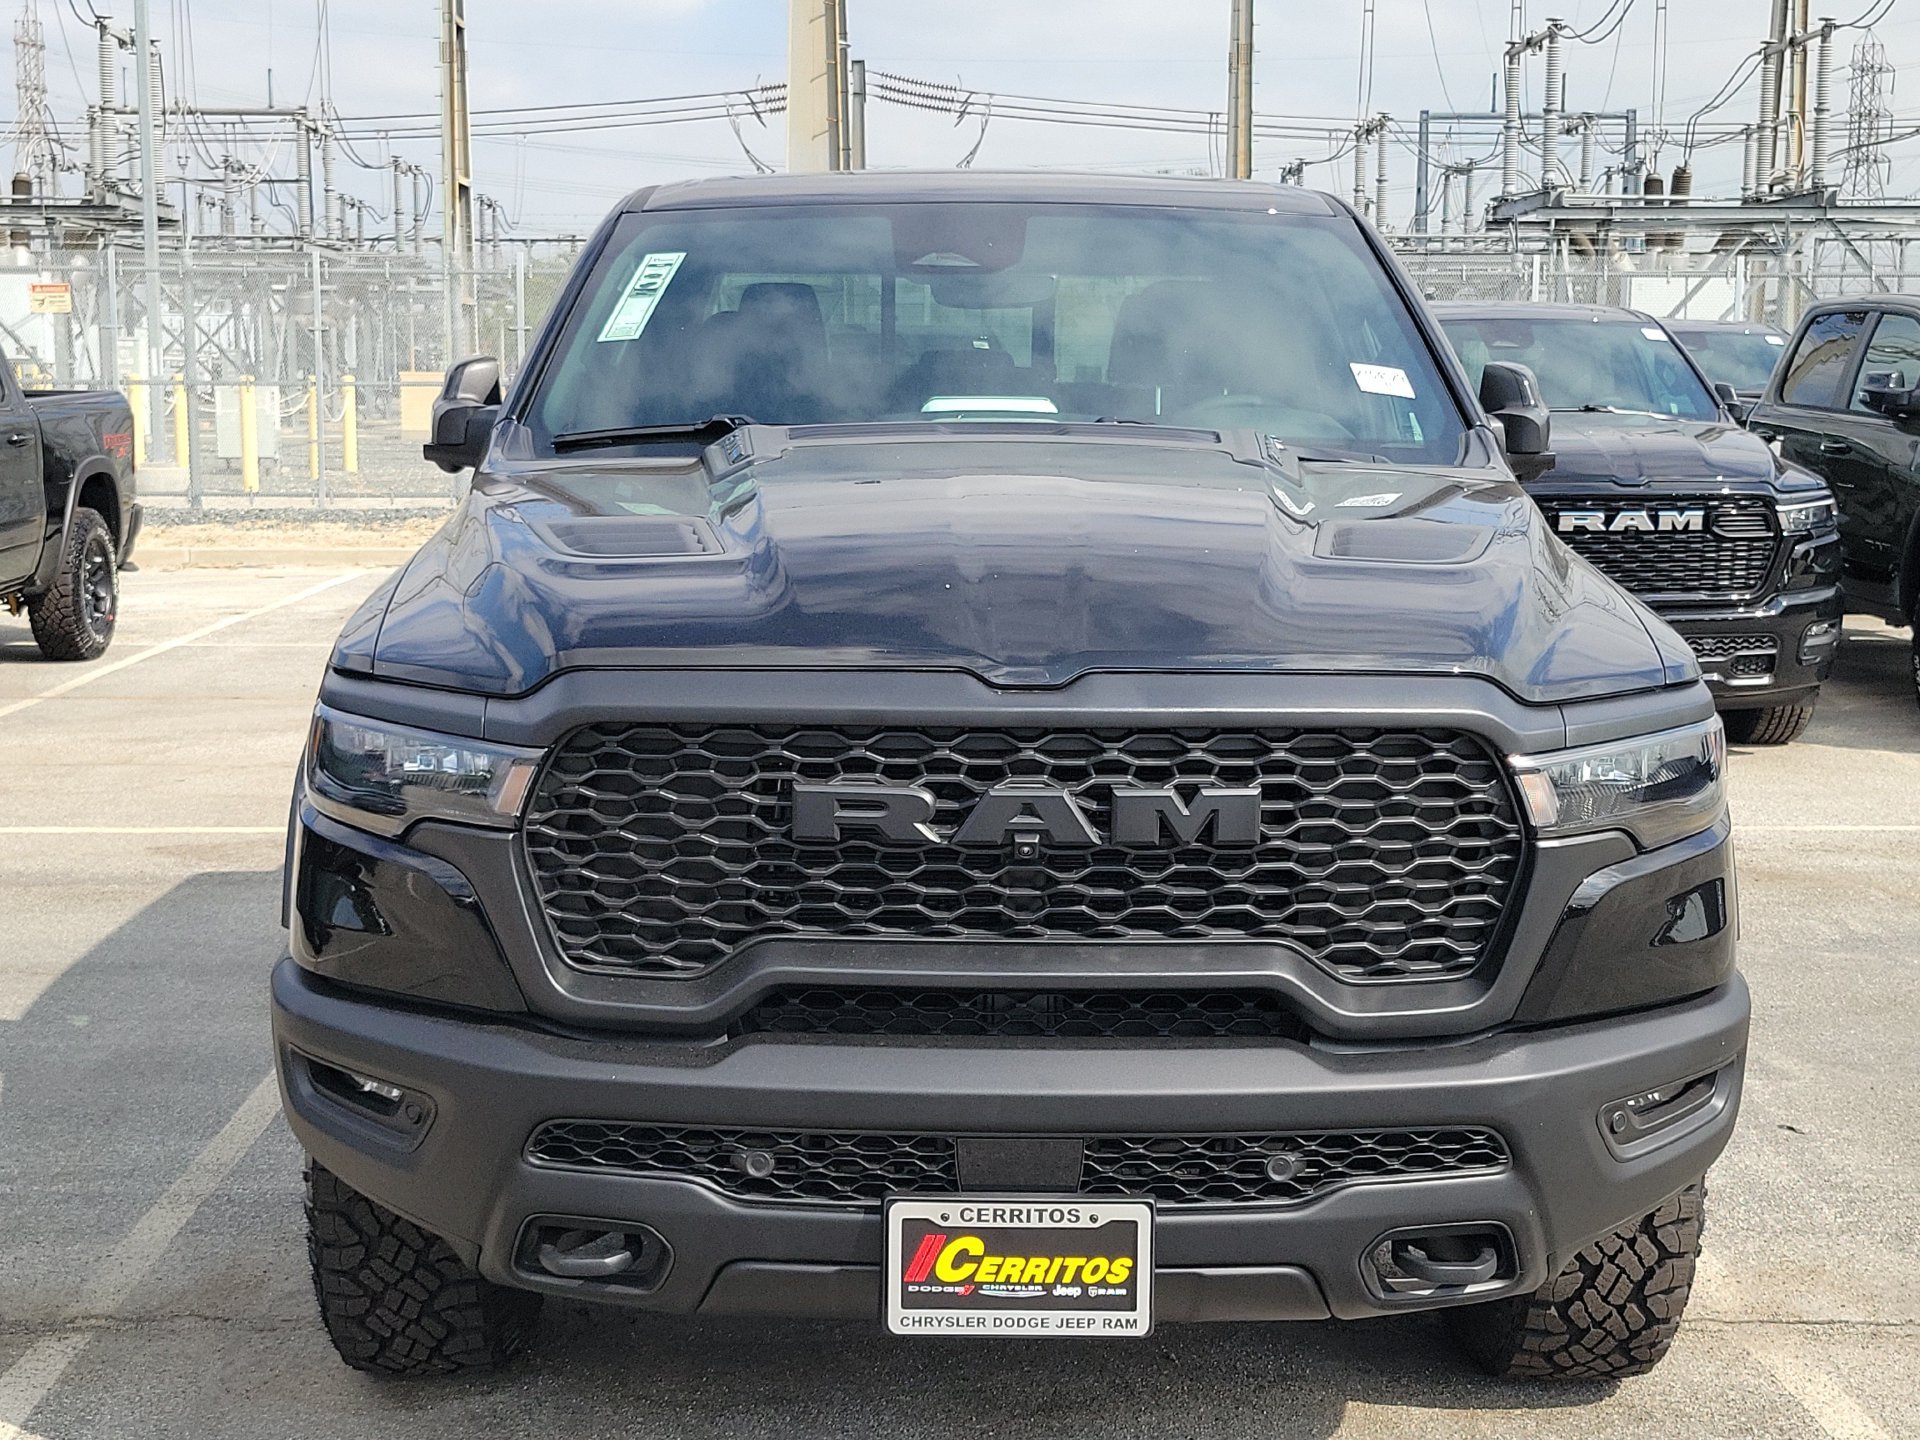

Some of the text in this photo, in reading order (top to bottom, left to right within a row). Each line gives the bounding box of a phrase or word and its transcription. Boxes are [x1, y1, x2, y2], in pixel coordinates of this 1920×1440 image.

[1558, 510, 1705, 531] RAM
[792, 783, 1262, 845] RAM
[959, 1207, 1081, 1224] CERRITOS
[908, 1285, 964, 1293] DODGE
[1052, 1284, 1082, 1299] Jeep
[1098, 1287, 1127, 1295] RAM
[900, 1316, 1138, 1330] CHRYSLER DODGE JEEP RAM
